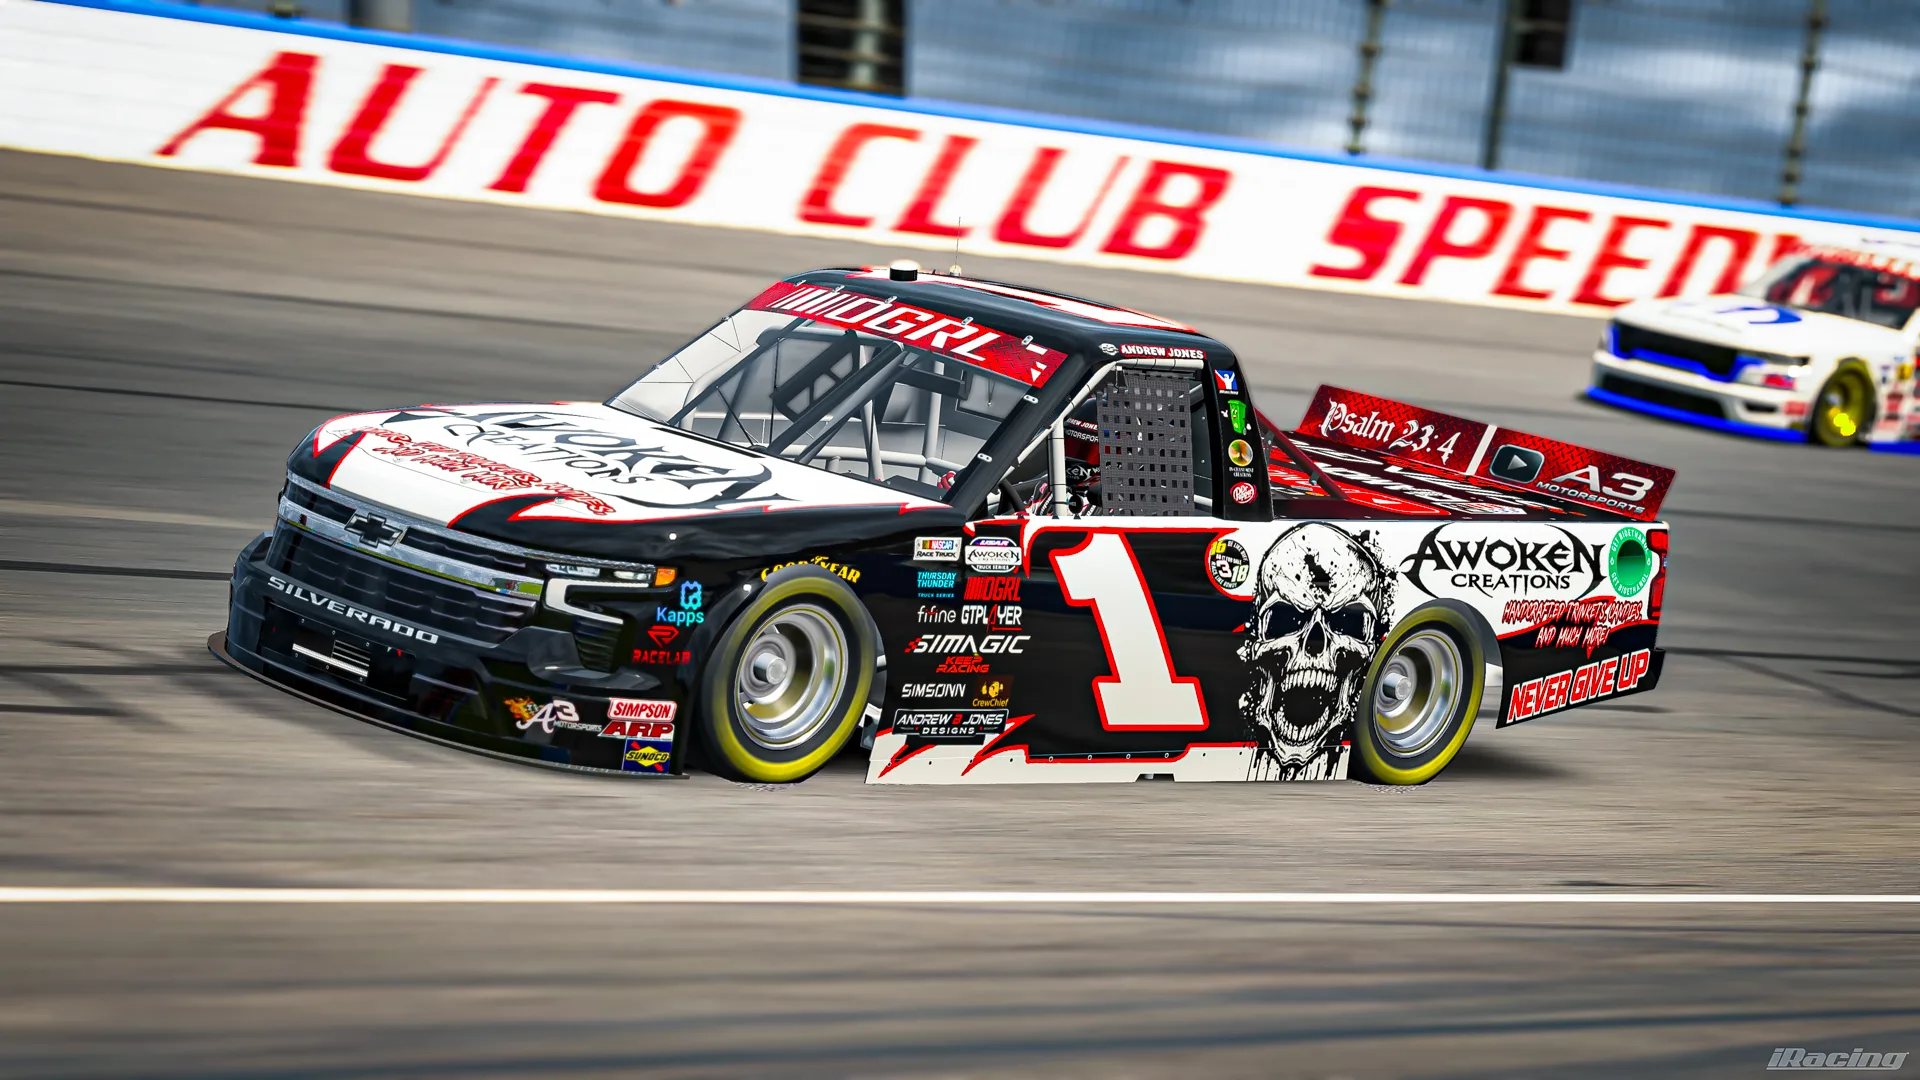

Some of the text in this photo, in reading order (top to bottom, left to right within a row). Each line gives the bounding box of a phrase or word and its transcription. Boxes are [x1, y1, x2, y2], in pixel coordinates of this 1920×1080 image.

[154, 51, 744, 208] AUTO
[796, 123, 1233, 259] CLUB
[1121, 344, 1204, 359] ANDREW JONES
[1319, 399, 1396, 443] Psalm
[1546, 464, 1654, 502] A3
[1535, 480, 1646, 515] MOTORSPORTS
[931, 540, 953, 550] NASCAR
[1211, 540, 1227, 555] 16
[967, 549, 1020, 563] AWOKEN
[1400, 522, 1609, 600] AWOKEN
[917, 571, 956, 580] THURSDAY
[1216, 560, 1232, 578] 3
[1231, 564, 1249, 583] 18
[917, 580, 954, 588] THUNDER
[1450, 573, 1571, 598] CREATIONS
[267, 575, 439, 645] SILVERADO
[656, 606, 705, 627] Kapps
[917, 605, 956, 623] fifine
[961, 604, 1022, 625] GTPLAYER
[1502, 600, 1567, 625] HANDCRAFTED
[1052, 529, 1207, 728] 1
[1535, 626, 1557, 648] AND
[1556, 626, 1583, 648] MUCH
[911, 634, 1031, 654] SIMAGIC
[632, 649, 692, 664] RACELAB
[945, 655, 983, 665] KEEP
[936, 664, 990, 673] RACING
[901, 683, 966, 698] SIMSONN
[1506, 648, 1651, 724] NEVER GIVE UP
[613, 701, 671, 719] SIMPSON
[972, 698, 1009, 707] CrewChief
[516, 700, 580, 733] A3
[897, 713, 1005, 725] ANDREW B JONES
[553, 720, 602, 733] MOTORSPORTS
[602, 721, 674, 738] ARP
[922, 726, 976, 735] DESIGNS
[626, 751, 669, 762] SUNOCO
